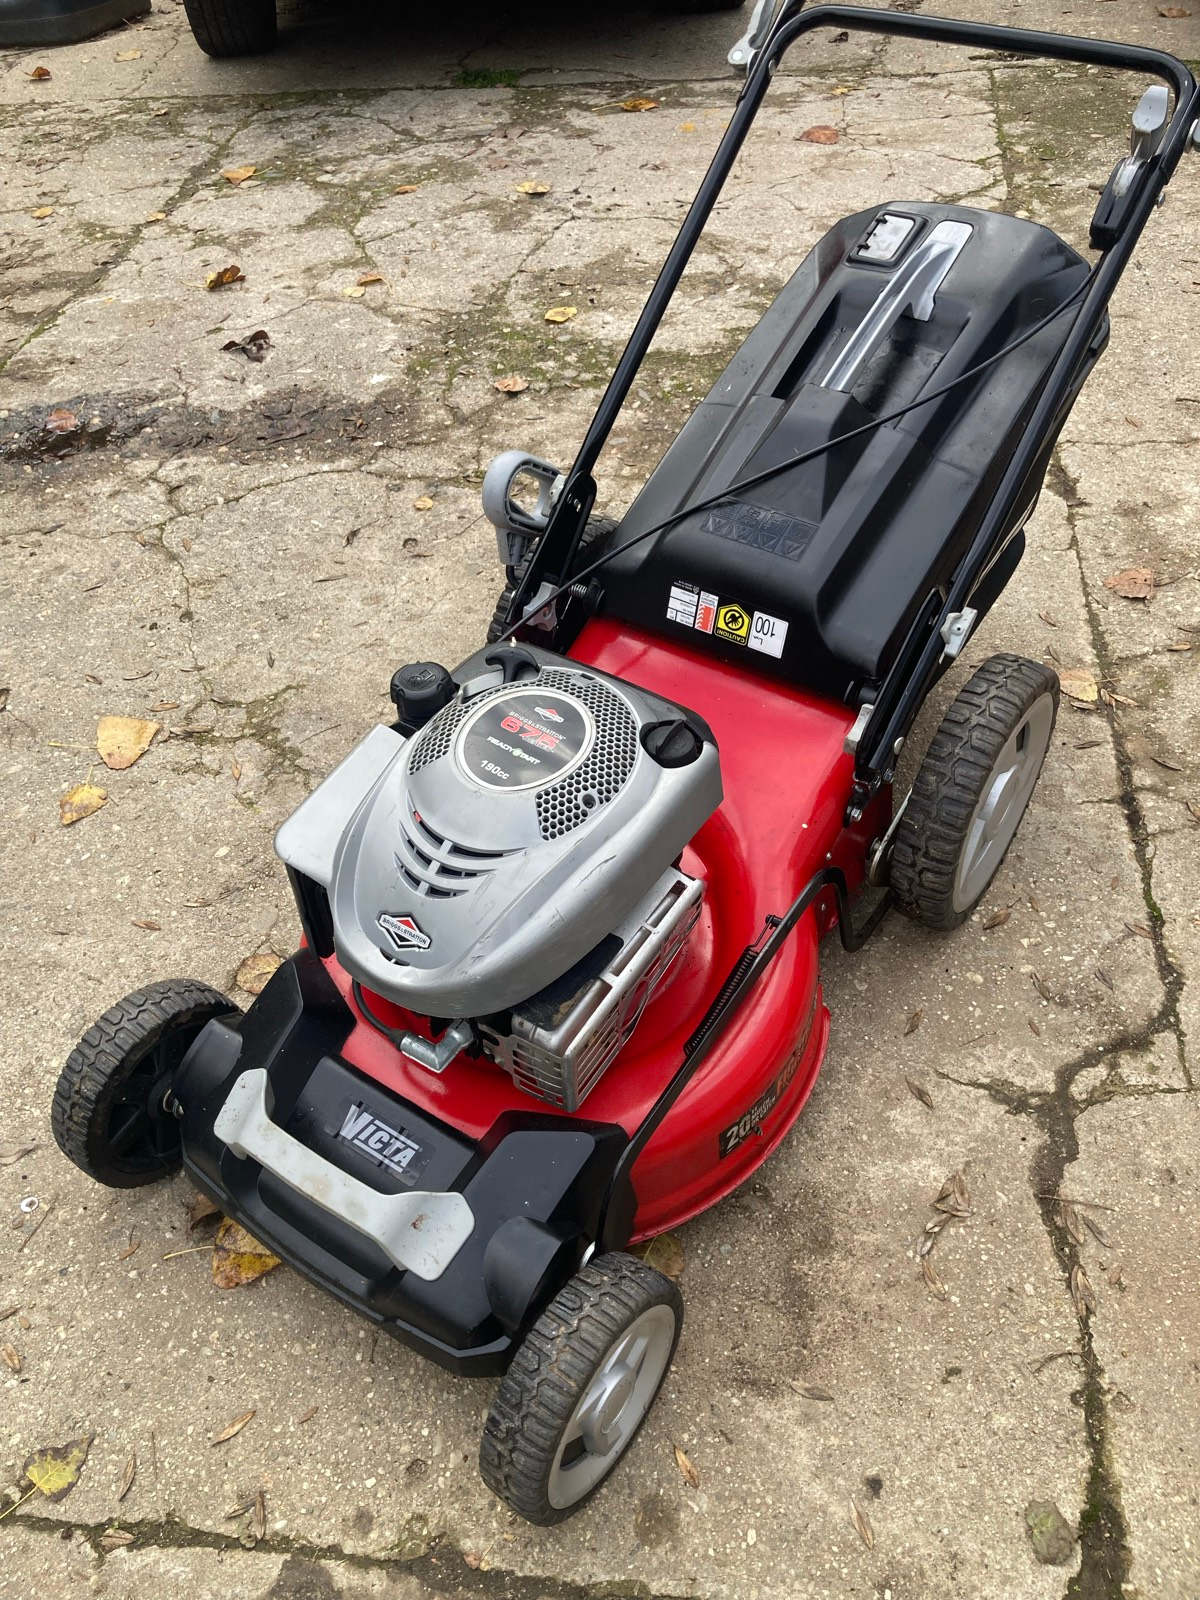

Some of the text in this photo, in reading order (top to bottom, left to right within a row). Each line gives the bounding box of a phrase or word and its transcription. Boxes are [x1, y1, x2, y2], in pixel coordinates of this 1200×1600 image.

[717, 629, 745, 643] CAUTION!
[755, 616, 776, 637] 100
[500, 716, 560, 748] 675
[480, 760, 509, 780] 190cc
[339, 1104, 418, 1172] VICTA
